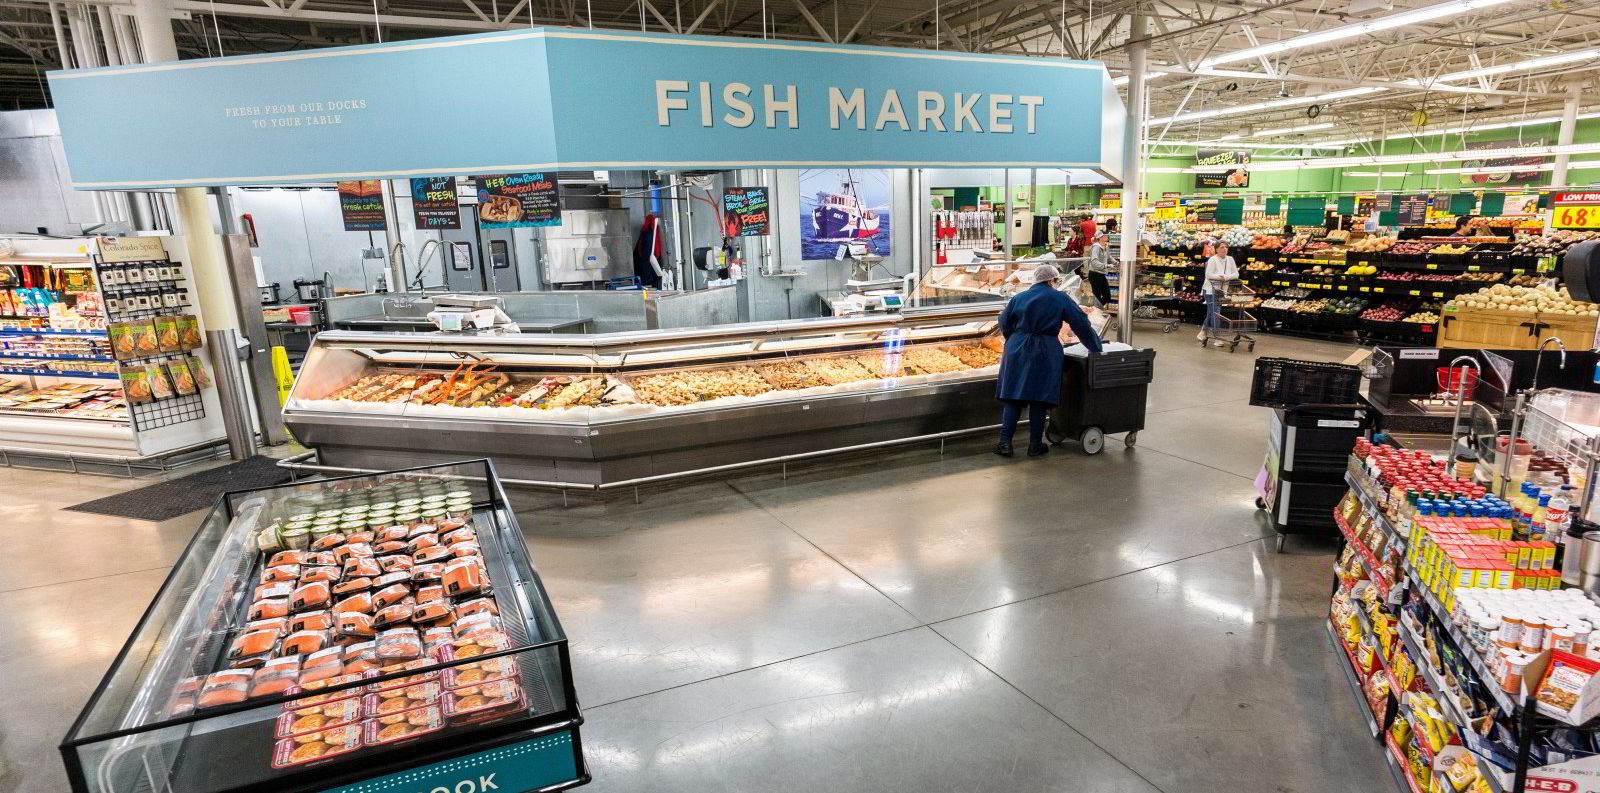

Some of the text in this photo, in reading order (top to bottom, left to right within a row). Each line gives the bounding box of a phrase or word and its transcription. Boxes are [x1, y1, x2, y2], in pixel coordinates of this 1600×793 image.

[224, 99, 367, 118] FRESH FROM OUR DOCKS
[655, 79, 1045, 134] FISH MARKET
[252, 114, 342, 128] TO YOUR TABLE
[506, 176, 523, 186] Oven
[523, 173, 543, 184] Ready
[431, 182, 447, 190] NOT
[501, 180, 553, 194] Seafood Meals
[427, 190, 456, 201] FRESH,
[1562, 193, 1583, 201] LOW
[343, 202, 361, 210] fresh
[421, 216, 428, 228] 7
[428, 216, 448, 226] DAYS
[741, 211, 768, 225] FREE!
[103, 242, 159, 252] Colorado Spice
